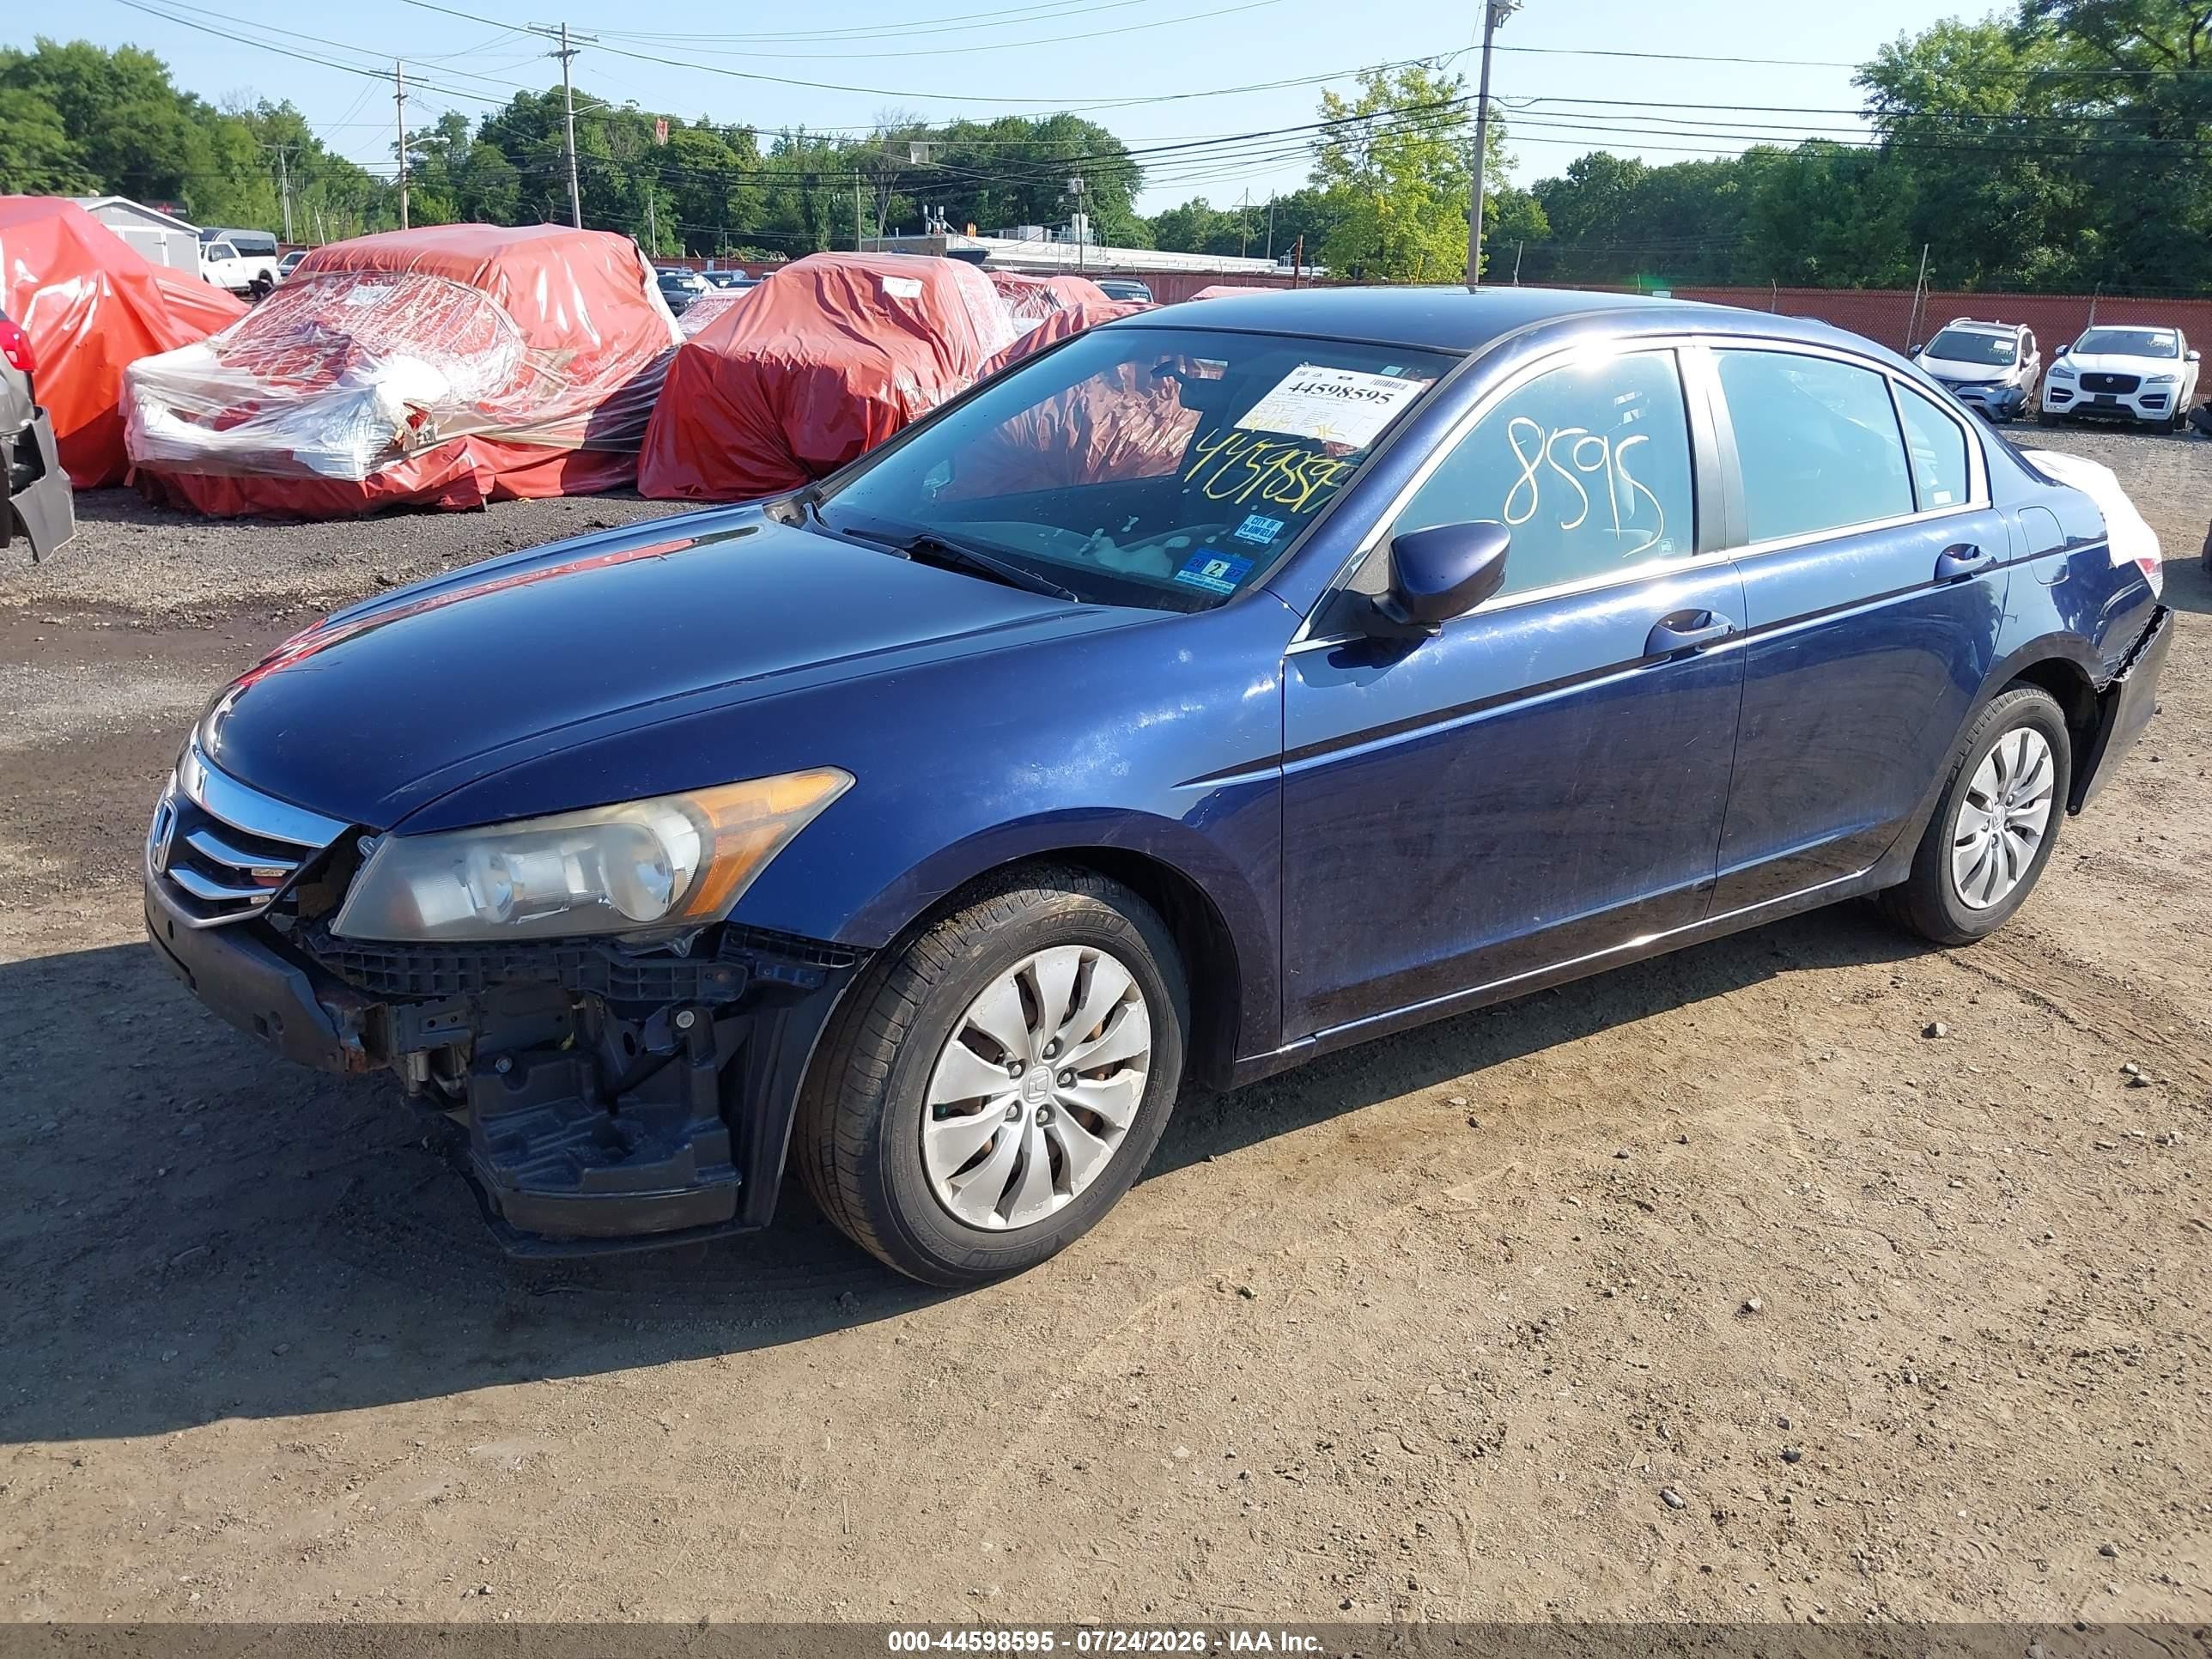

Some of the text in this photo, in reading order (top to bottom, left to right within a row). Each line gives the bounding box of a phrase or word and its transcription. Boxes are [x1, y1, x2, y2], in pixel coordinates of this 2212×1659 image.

[1288, 381, 1395, 405] 44598595
[1504, 417, 1664, 558] 8595
[1251, 517, 1279, 529] CITY OF
[1190, 558, 1206, 568] 20
[1208, 562, 1222, 575] 2
